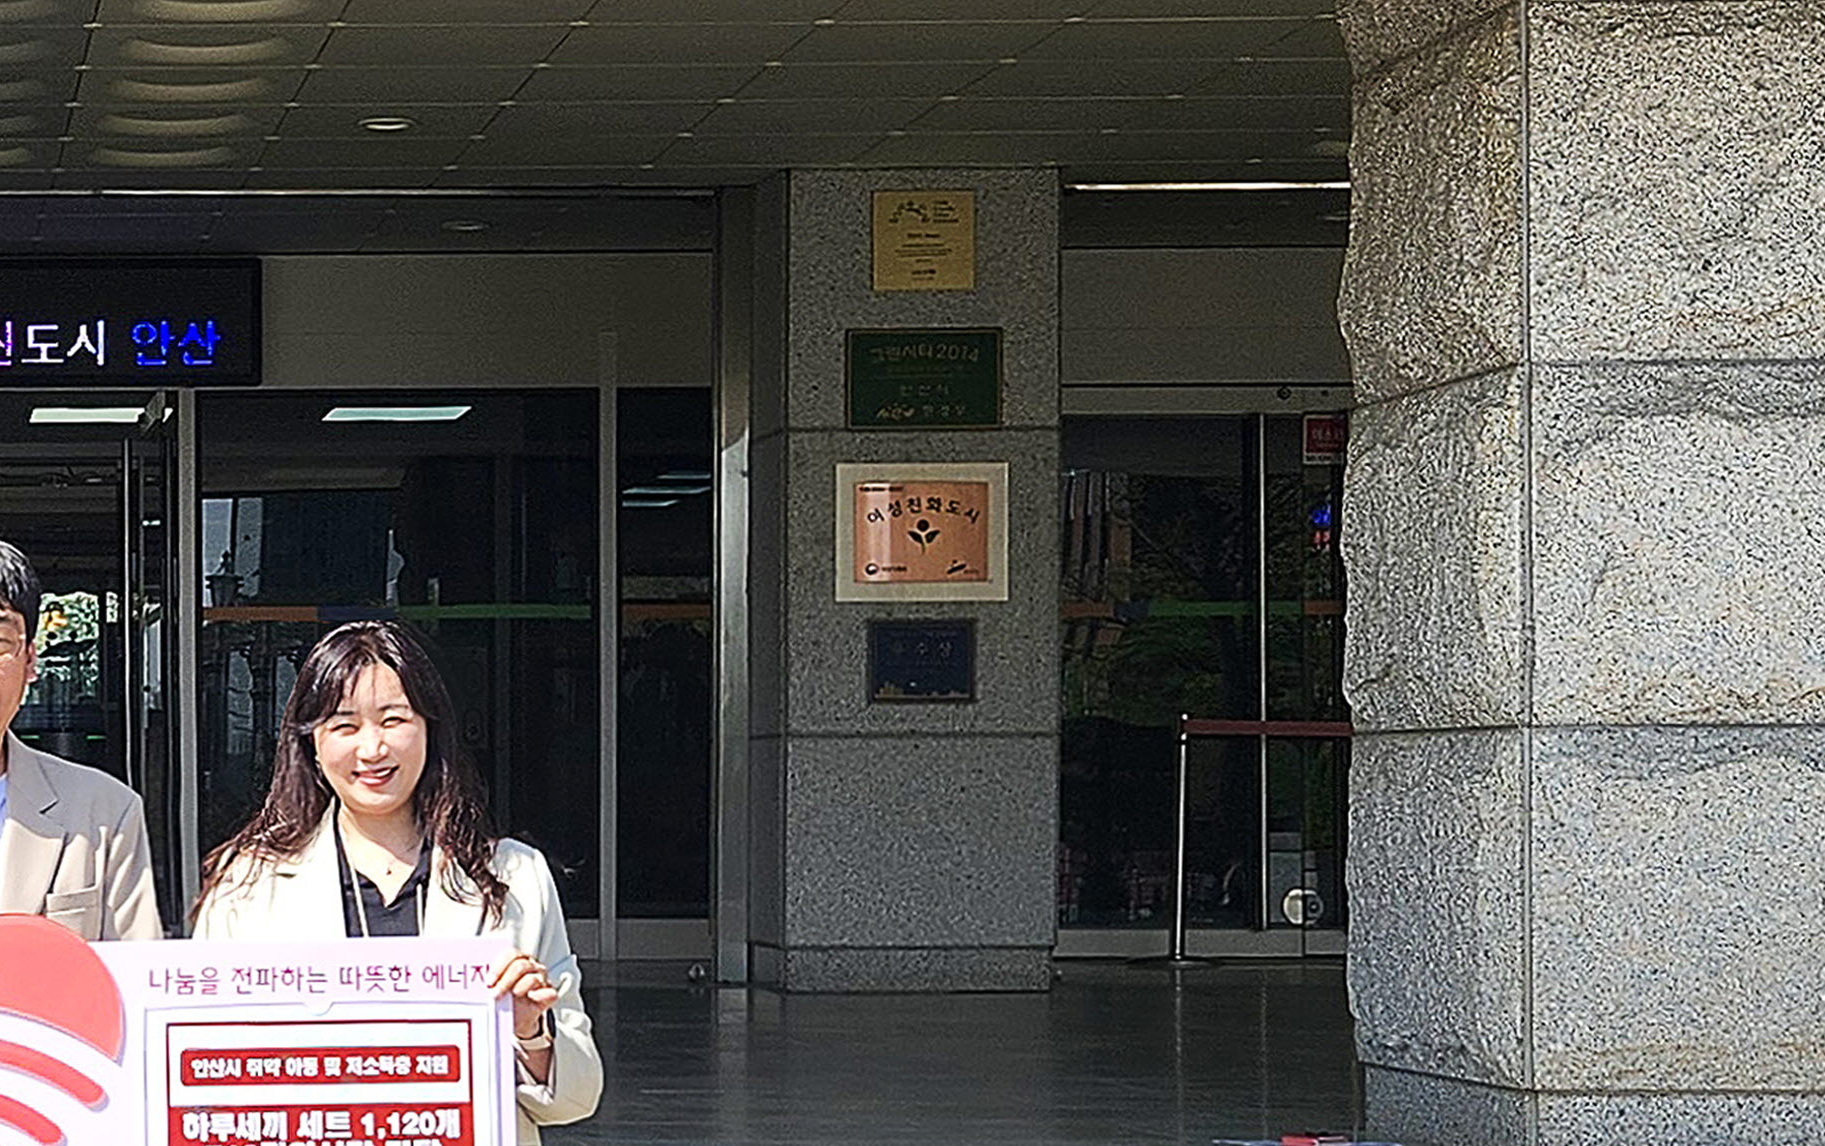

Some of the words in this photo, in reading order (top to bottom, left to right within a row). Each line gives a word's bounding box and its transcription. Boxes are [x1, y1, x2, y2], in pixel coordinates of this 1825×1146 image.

[131, 320, 220, 367] 안산
[866, 495, 981, 525] 여성친화도시
[149, 966, 220, 995] 나눔을
[232, 965, 328, 994] 전파하는
[339, 964, 412, 993] 따뜻한
[190, 1057, 242, 1079] 안산시
[181, 1111, 288, 1143] 하루세끼
[296, 1110, 353, 1141] 세트
[361, 1108, 462, 1140] 1,120개
